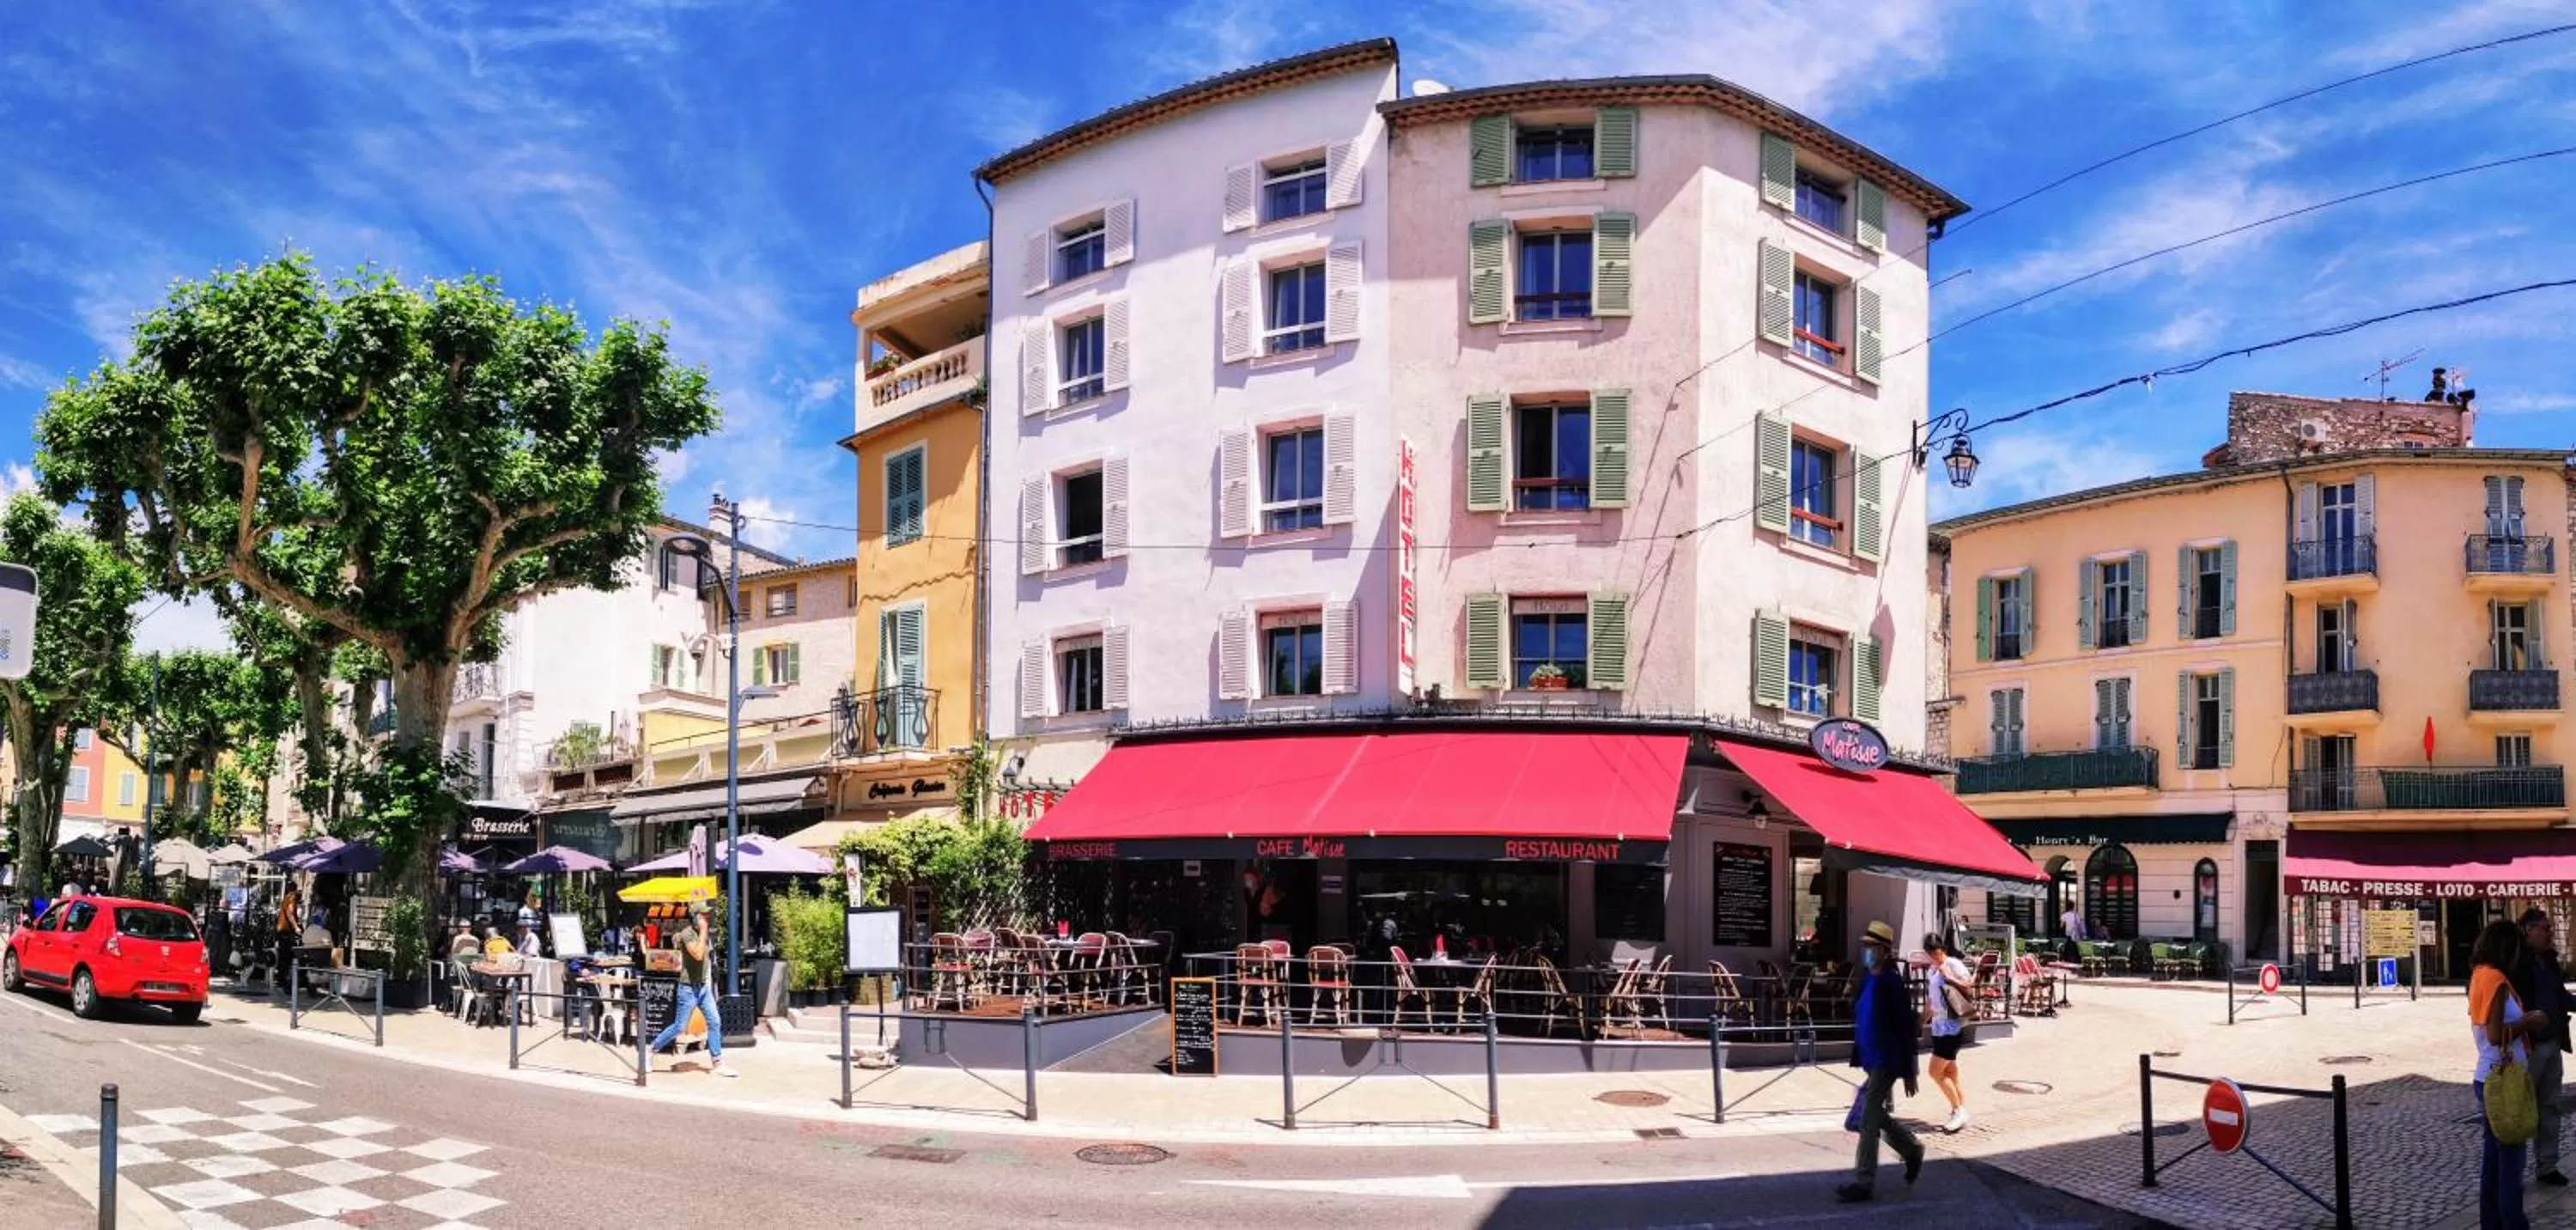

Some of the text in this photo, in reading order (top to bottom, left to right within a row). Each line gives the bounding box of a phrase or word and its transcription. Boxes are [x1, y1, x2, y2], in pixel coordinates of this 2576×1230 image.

[1821, 729, 1880, 763] Matisse
[471, 817, 530, 834] Brasserie
[1048, 843, 1118, 857] BRASSERIE
[1505, 840, 1619, 859] RESTAURANT
[2301, 879, 2350, 894] TABAC
[2362, 881, 2423, 896] PRESSE
[2436, 883, 2475, 897] LOTO
[2487, 883, 2561, 897] CARTERIE
